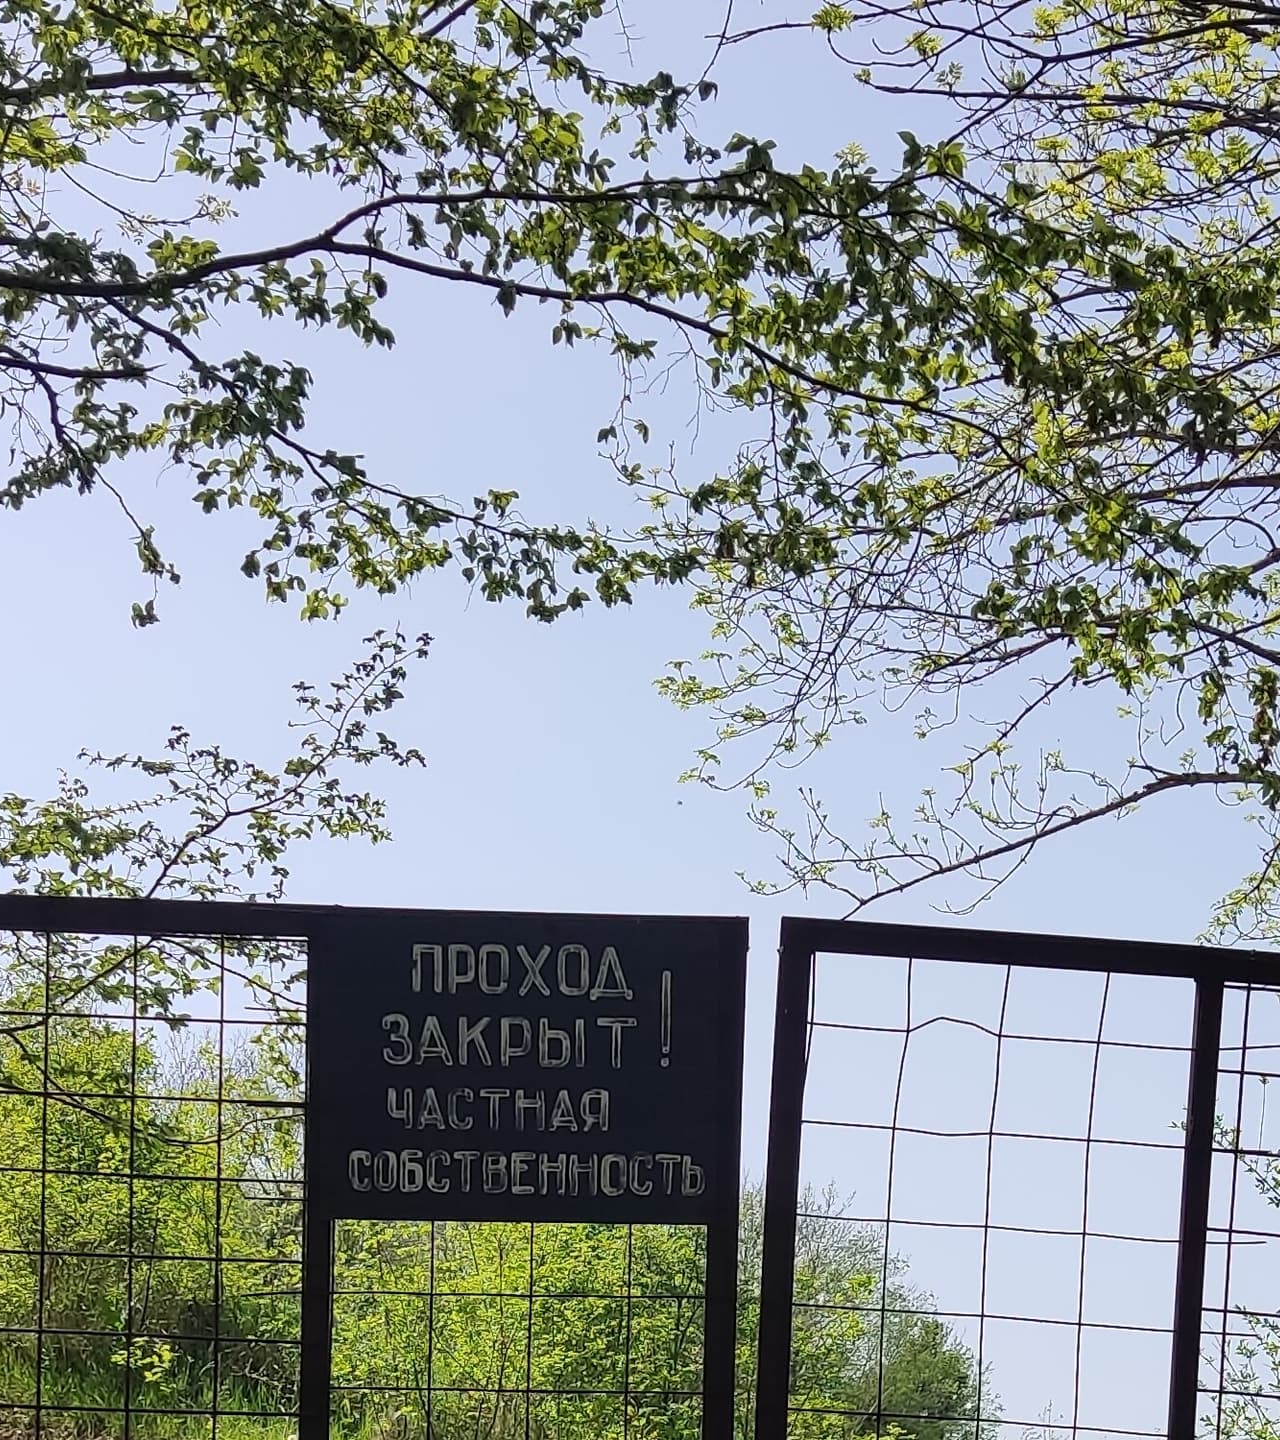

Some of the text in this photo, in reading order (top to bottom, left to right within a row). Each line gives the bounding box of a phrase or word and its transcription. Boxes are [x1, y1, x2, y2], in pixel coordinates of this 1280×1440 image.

[411, 944, 633, 1000] ПРОХОД
[381, 1013, 637, 1068] ЗАКРЫТ
[386, 1087, 611, 1132] ЧАСТНАЯ
[348, 1149, 706, 1197] СОБСТВЕННОСТЬ
